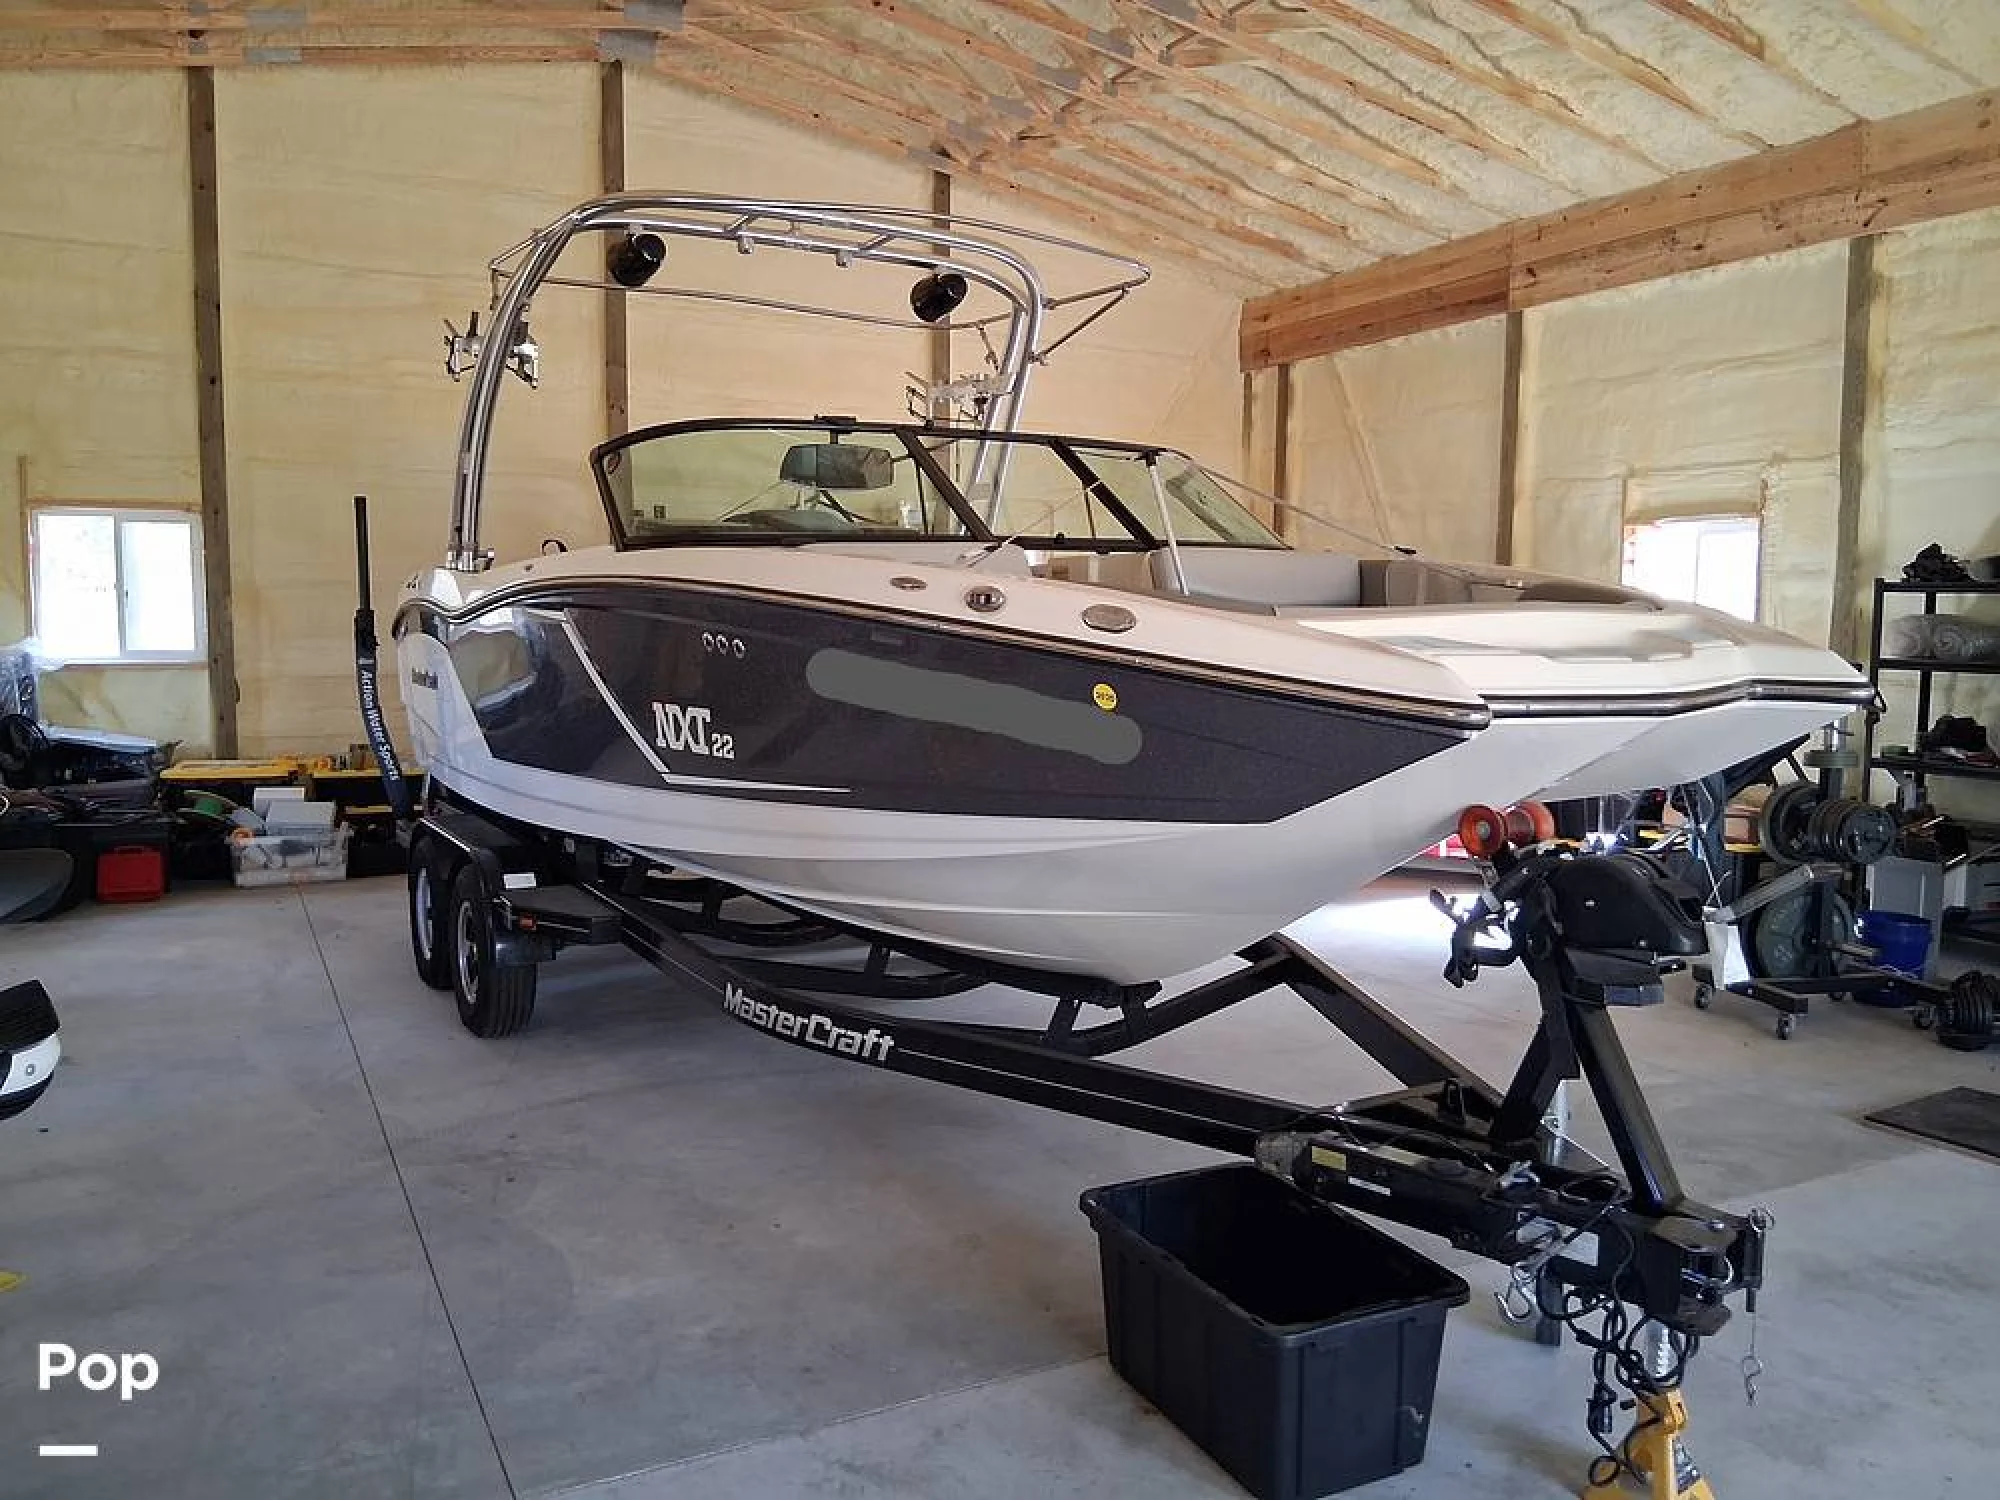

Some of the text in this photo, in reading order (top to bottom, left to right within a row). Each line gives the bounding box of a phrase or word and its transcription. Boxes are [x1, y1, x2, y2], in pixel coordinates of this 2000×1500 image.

[362, 670, 373, 708] Action
[367, 710, 385, 742] Water
[652, 701, 735, 759] NXT 22
[723, 981, 894, 1061] MasterCraft
